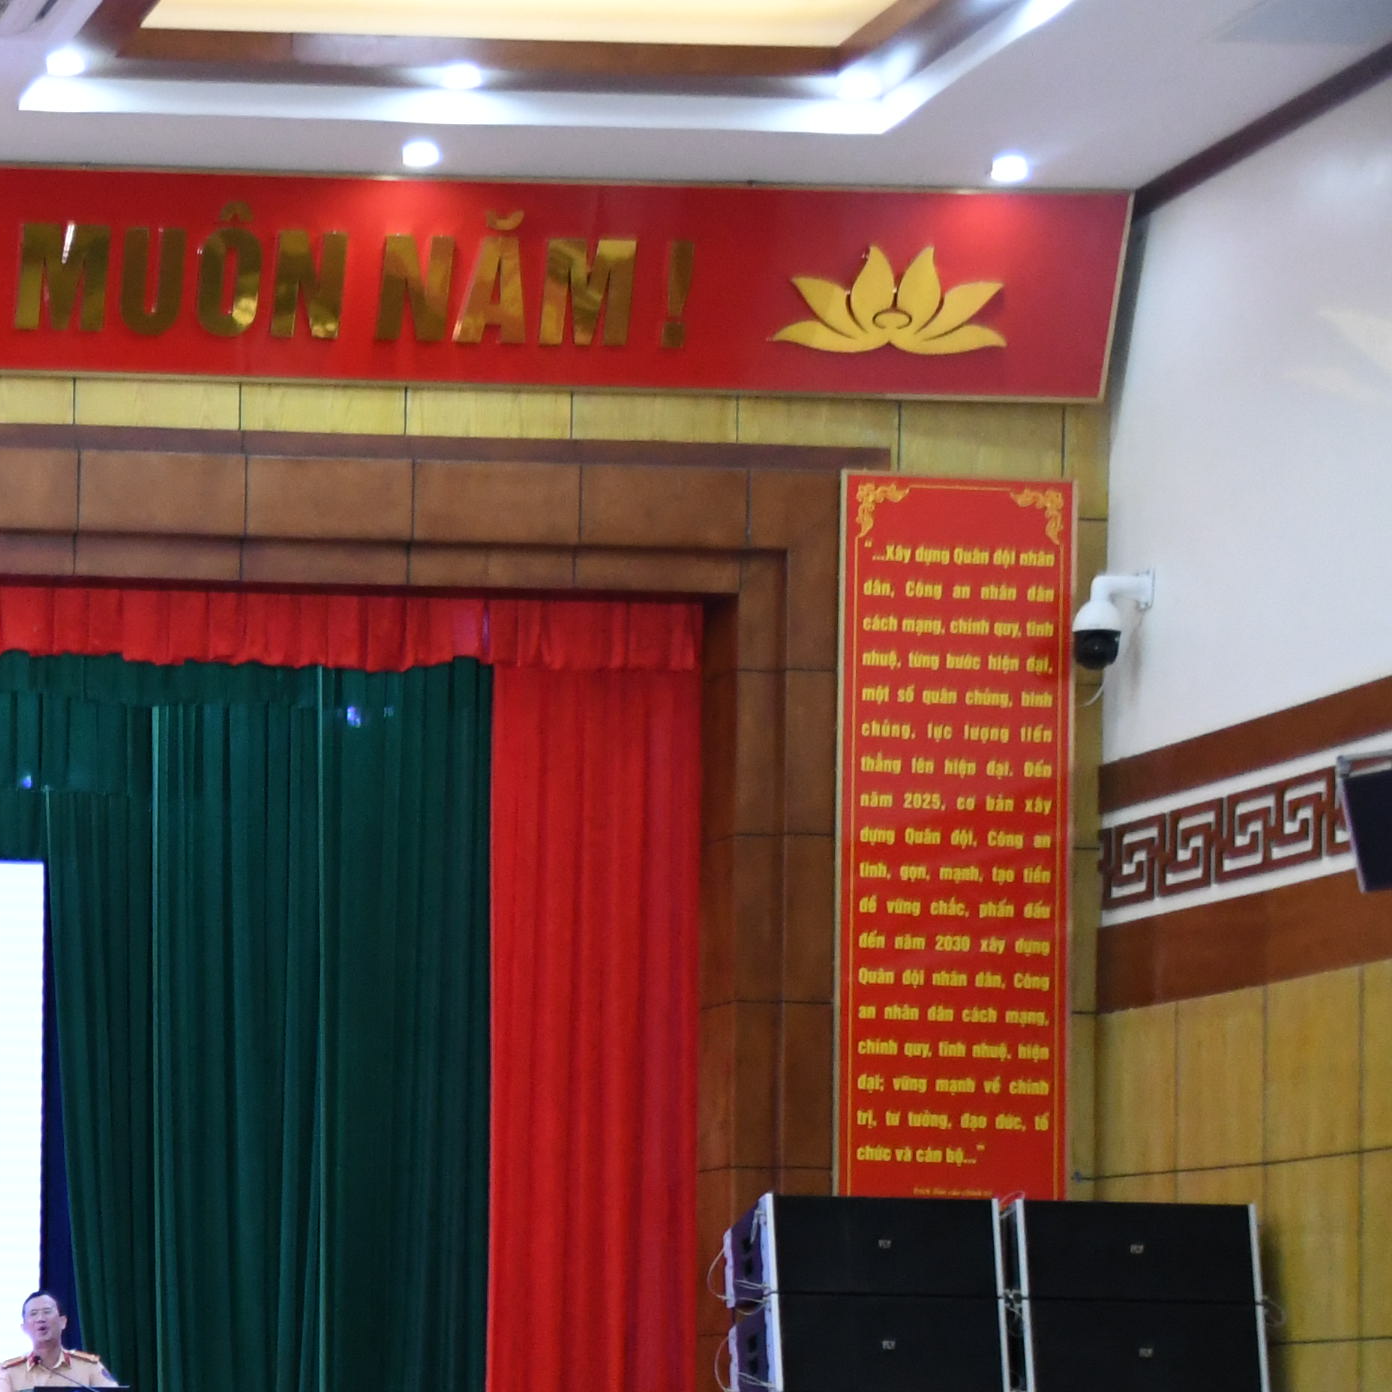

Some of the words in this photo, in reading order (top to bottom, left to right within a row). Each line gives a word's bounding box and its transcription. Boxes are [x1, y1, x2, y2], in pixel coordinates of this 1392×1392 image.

[15, 201, 348, 339] MUÔN
[915, 544, 951, 566] dựng
[954, 546, 990, 565] Quân
[993, 547, 1016, 568] đội
[1020, 548, 1056, 567] nhân
[864, 577, 895, 598] dân,
[906, 579, 943, 600] Công
[953, 583, 971, 599] an
[981, 582, 1017, 601] nhân
[1027, 583, 1055, 602] dân
[860, 789, 894, 808] năm
[903, 790, 946, 811] 2025,
[957, 795, 976, 811] cơ
[1025, 796, 1052, 814] xây
[905, 826, 942, 845] Quân
[988, 828, 1025, 849] Công
[1034, 833, 1052, 849] an
[935, 933, 972, 952] 2030
